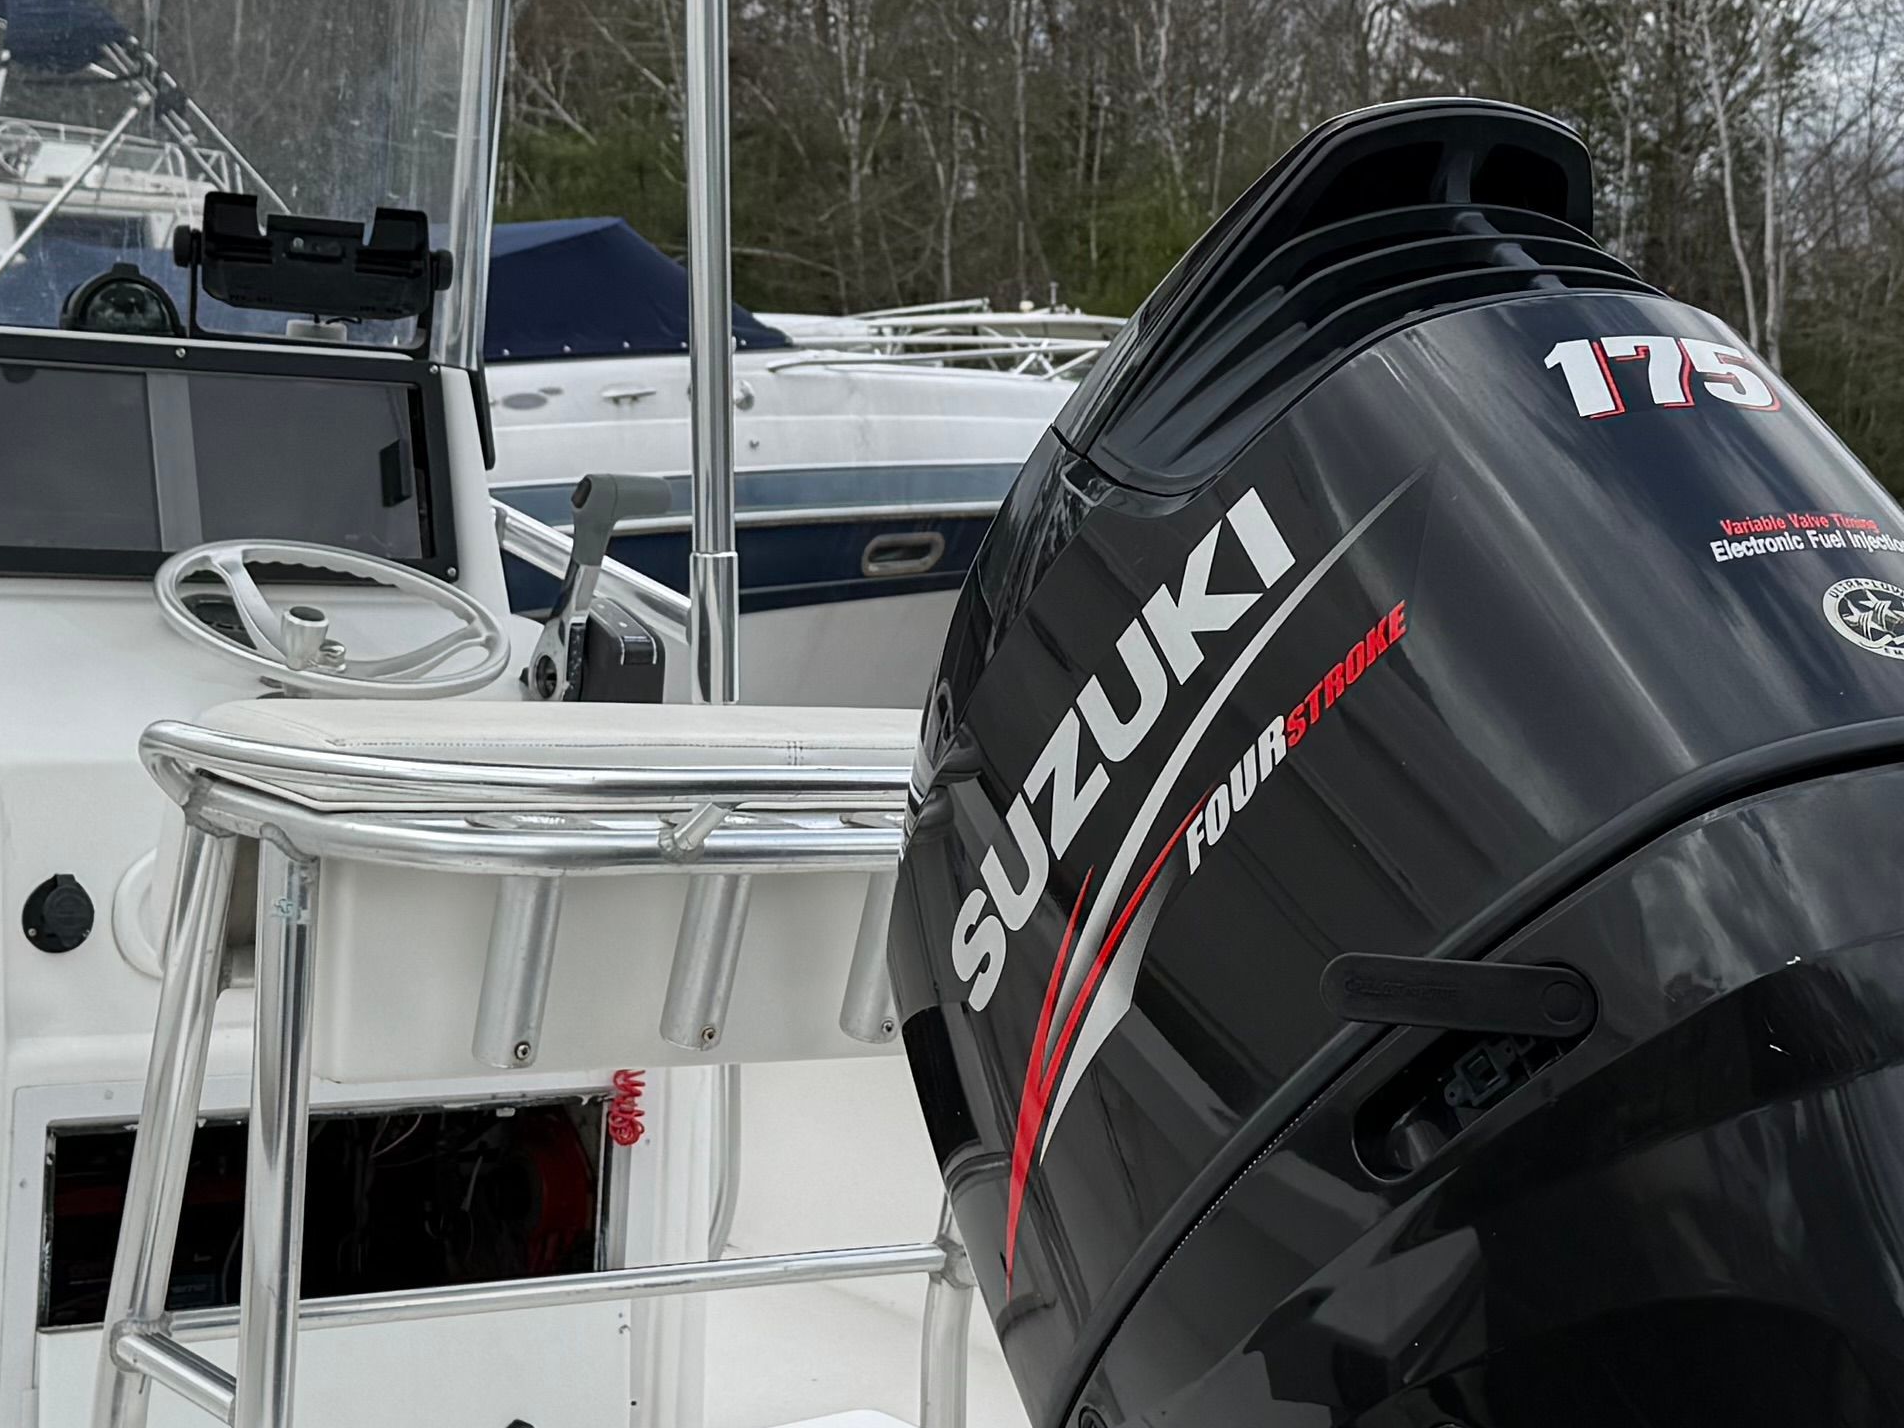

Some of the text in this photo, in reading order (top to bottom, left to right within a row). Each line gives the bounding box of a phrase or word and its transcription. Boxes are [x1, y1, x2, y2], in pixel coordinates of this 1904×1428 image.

[1543, 335, 1782, 419] 175
[1709, 530, 1804, 563] Electronic
[1807, 529, 1846, 549] Fuel
[1719, 513, 1880, 536] Variable Valve Timing
[950, 485, 1296, 1013] SUZUKI
